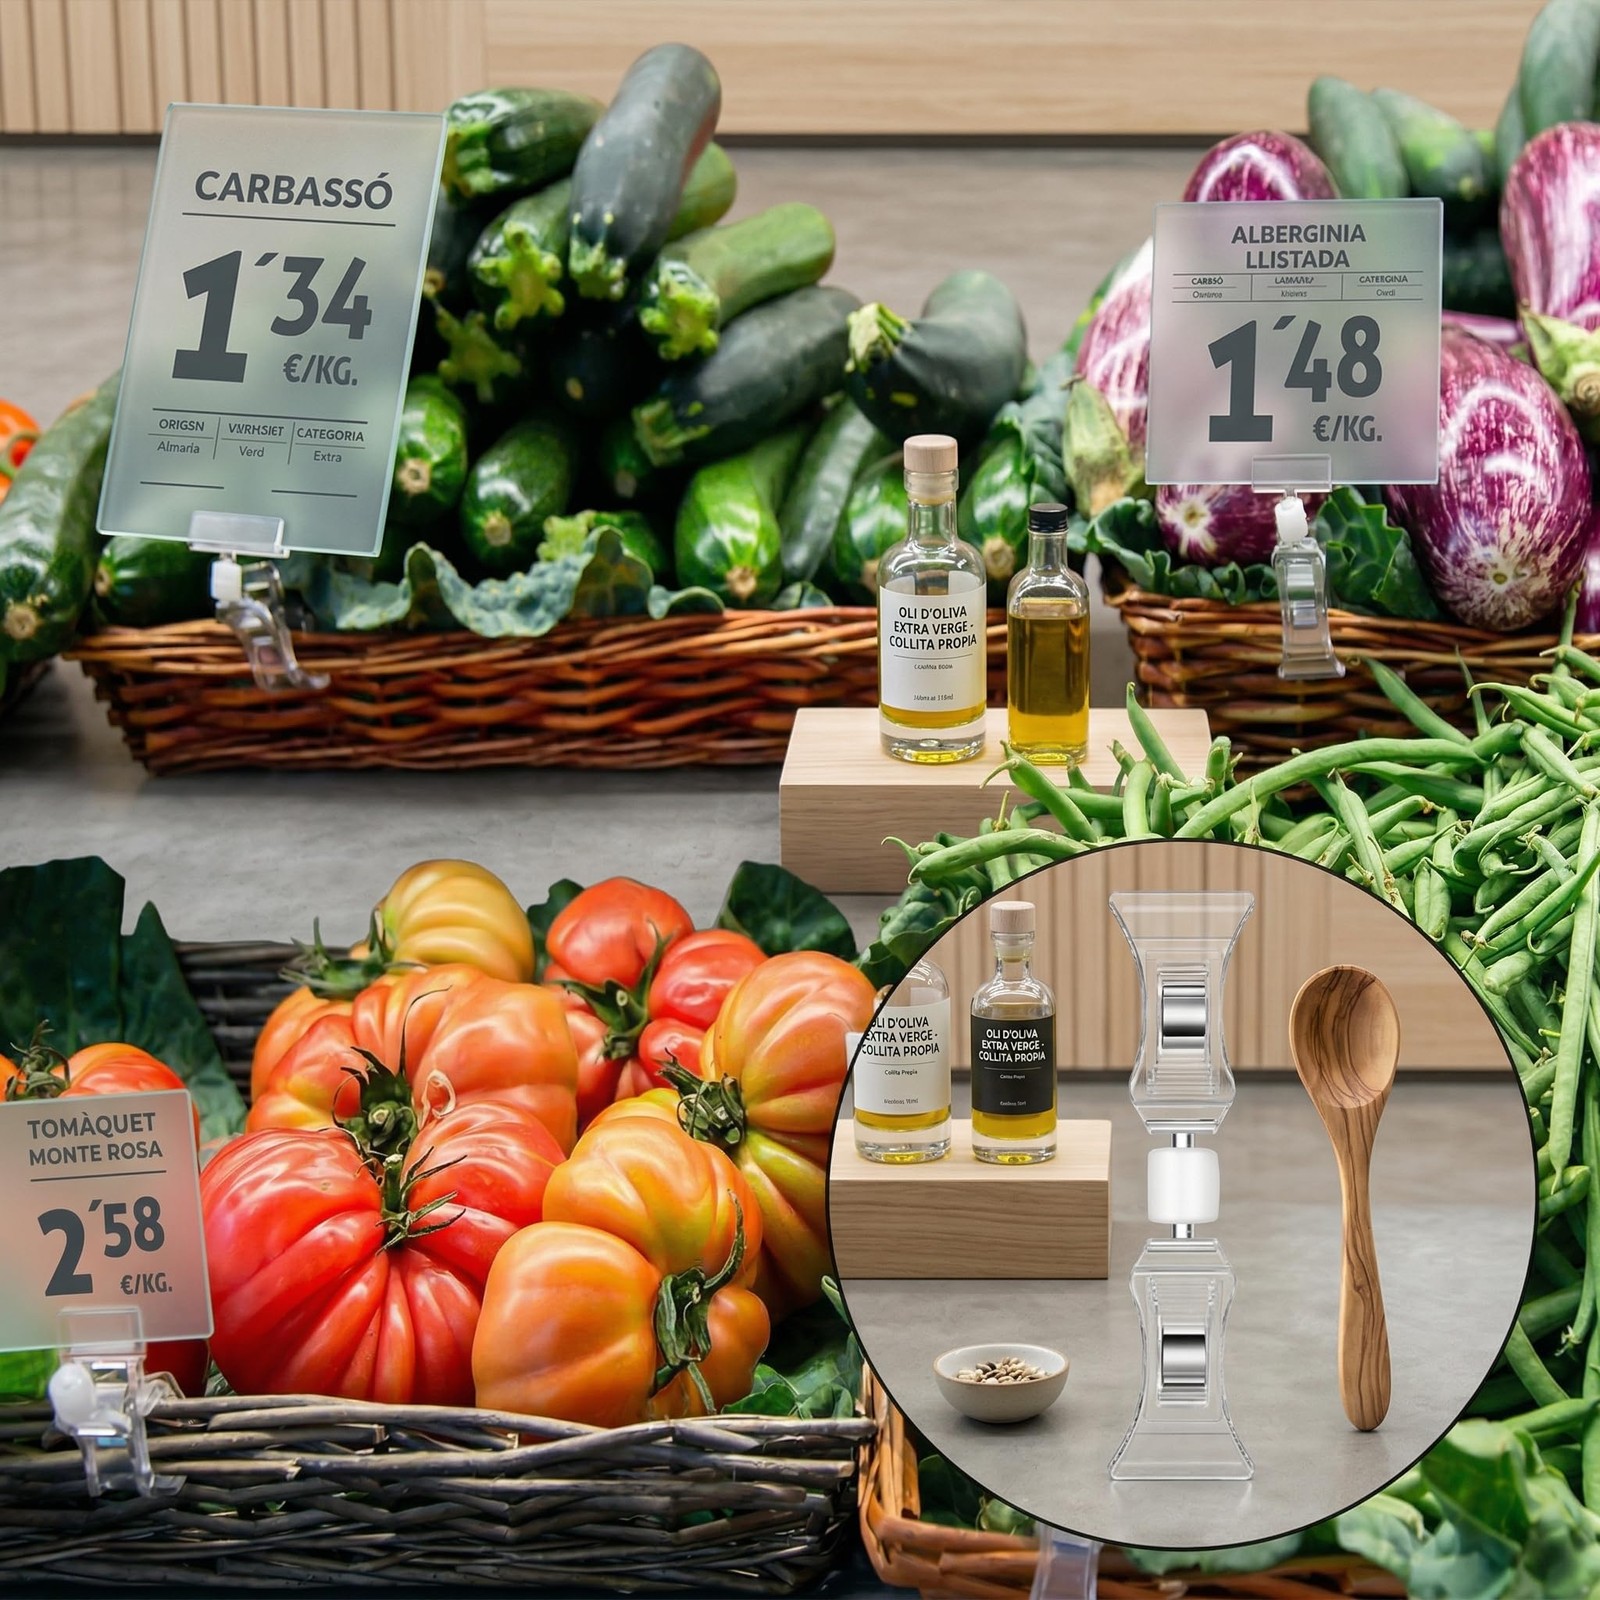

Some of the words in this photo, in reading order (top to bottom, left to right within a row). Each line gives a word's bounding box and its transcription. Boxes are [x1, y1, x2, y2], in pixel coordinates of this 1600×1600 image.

[195, 171, 394, 210] CARBASSÓ
[1231, 223, 1367, 245] ALBERGINIA
[1246, 249, 1351, 270] LLISTADA
[283, 353, 358, 386] €/KG.
[296, 427, 365, 443] CATEGORIA
[1312, 415, 1383, 443] €/KG.
[239, 445, 265, 458] Verd
[313, 450, 343, 463] Extra
[898, 606, 918, 619] OLI
[921, 605, 967, 620] D'OLIVA
[894, 620, 929, 635] EXTRA
[932, 620, 968, 635] VERGE
[889, 635, 936, 651] COLLITA
[938, 634, 977, 651] PROPIA
[888, 1016, 929, 1029] D'OLIVA
[899, 1029, 933, 1043] VERGE
[986, 1028, 1001, 1039] OLI
[1002, 1028, 1039, 1040] D'OLIVA
[903, 1043, 940, 1057] PROPIA
[981, 1039, 1009, 1051] EXTRA
[1010, 1040, 1040, 1051] VERGE
[978, 1050, 1013, 1063] COLLITA
[1014, 1051, 1046, 1063] PROPIA
[27, 1112, 156, 1140] TOMÀQUET
[29, 1144, 102, 1166] MONTE
[107, 1140, 163, 1161] ROSA
[120, 1272, 173, 1295] €/KG.
